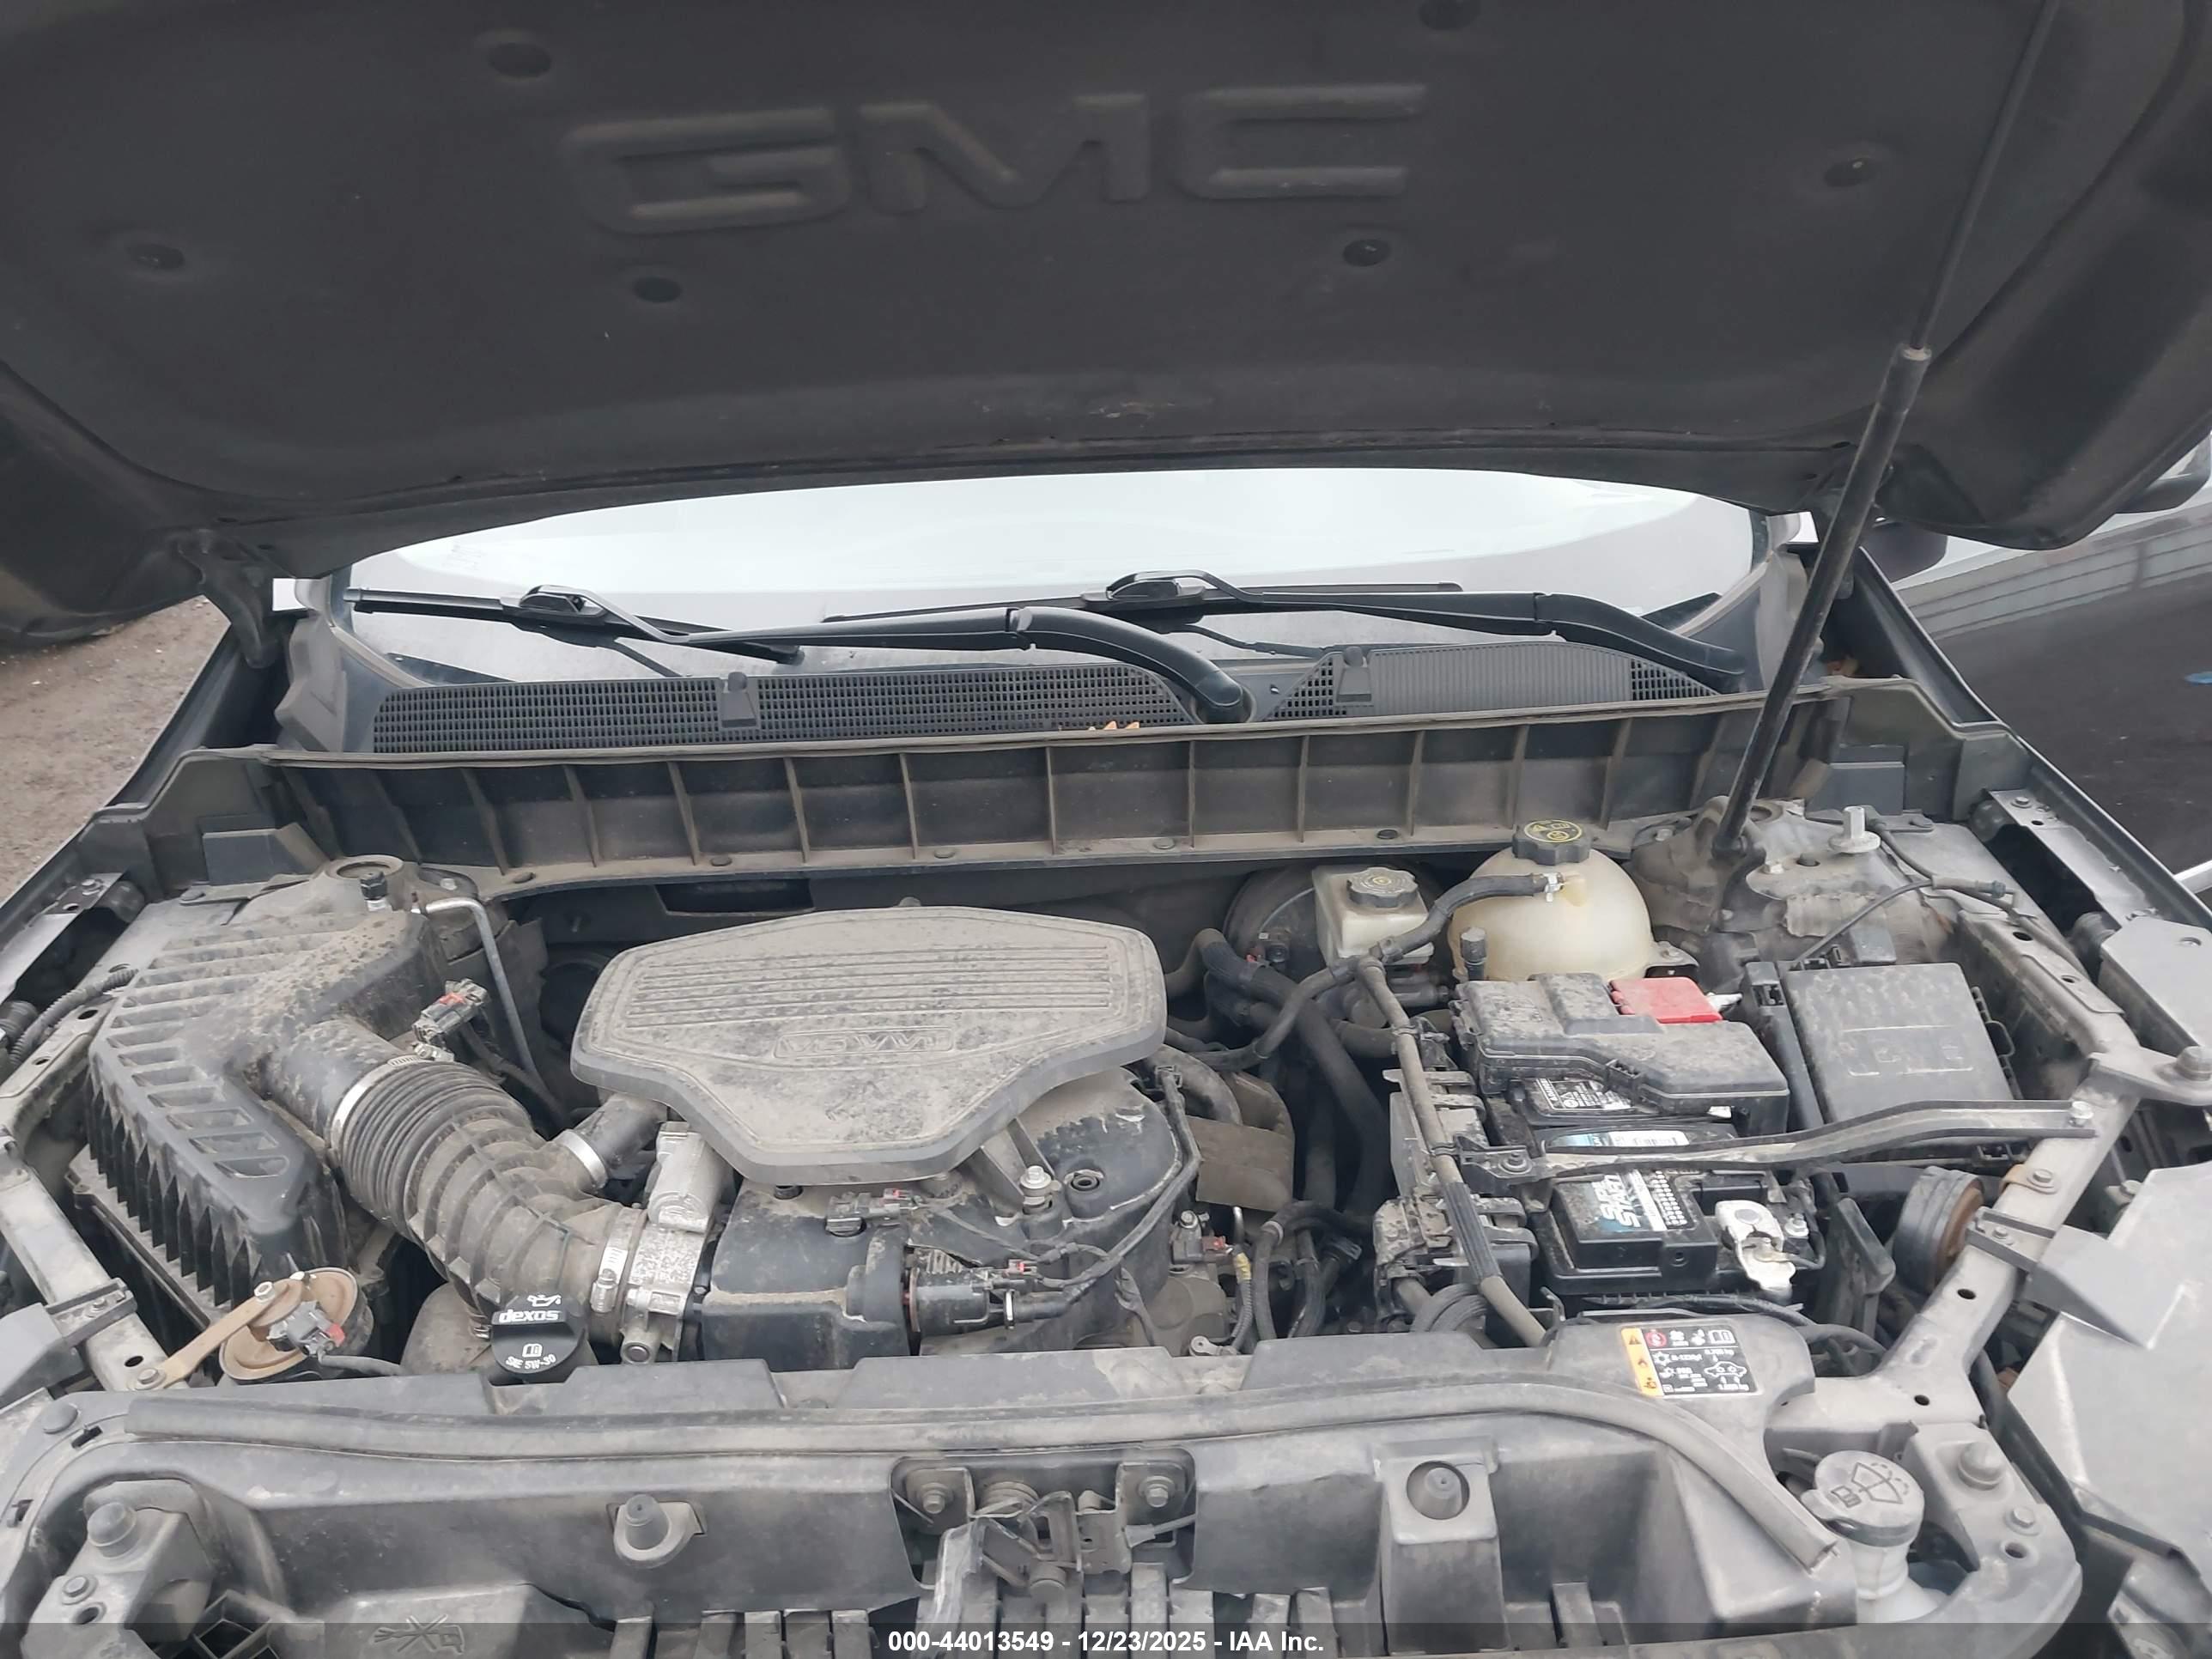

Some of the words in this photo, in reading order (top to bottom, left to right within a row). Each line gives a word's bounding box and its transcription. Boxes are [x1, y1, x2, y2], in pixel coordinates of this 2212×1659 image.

[562, 82, 1430, 236] GMC
[1591, 1180, 1622, 1220] SUPE
[498, 1309, 560, 1323] dexos
[525, 1353, 556, 1370] 5W-30
